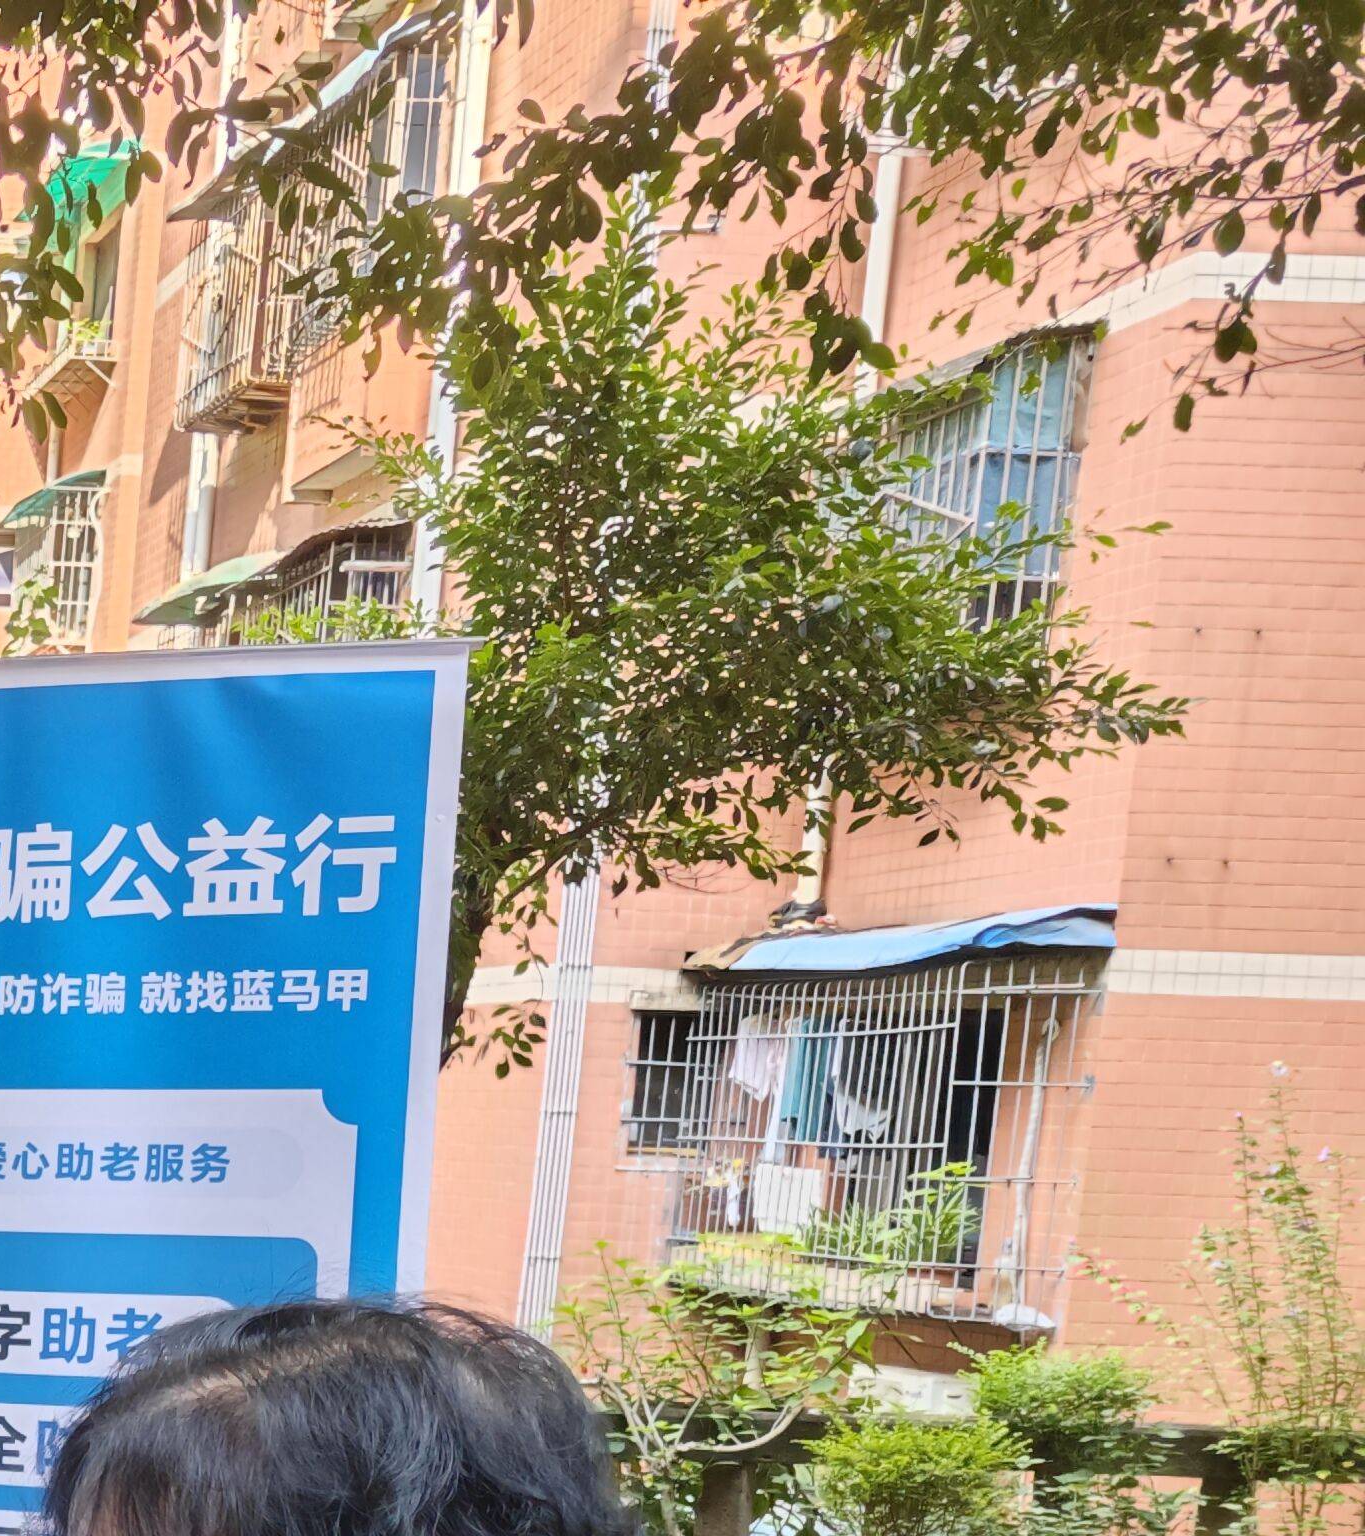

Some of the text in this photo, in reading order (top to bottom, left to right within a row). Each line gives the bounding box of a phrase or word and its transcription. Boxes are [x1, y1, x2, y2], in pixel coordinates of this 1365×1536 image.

[140, 968, 370, 1013] 就找蓝马甲
